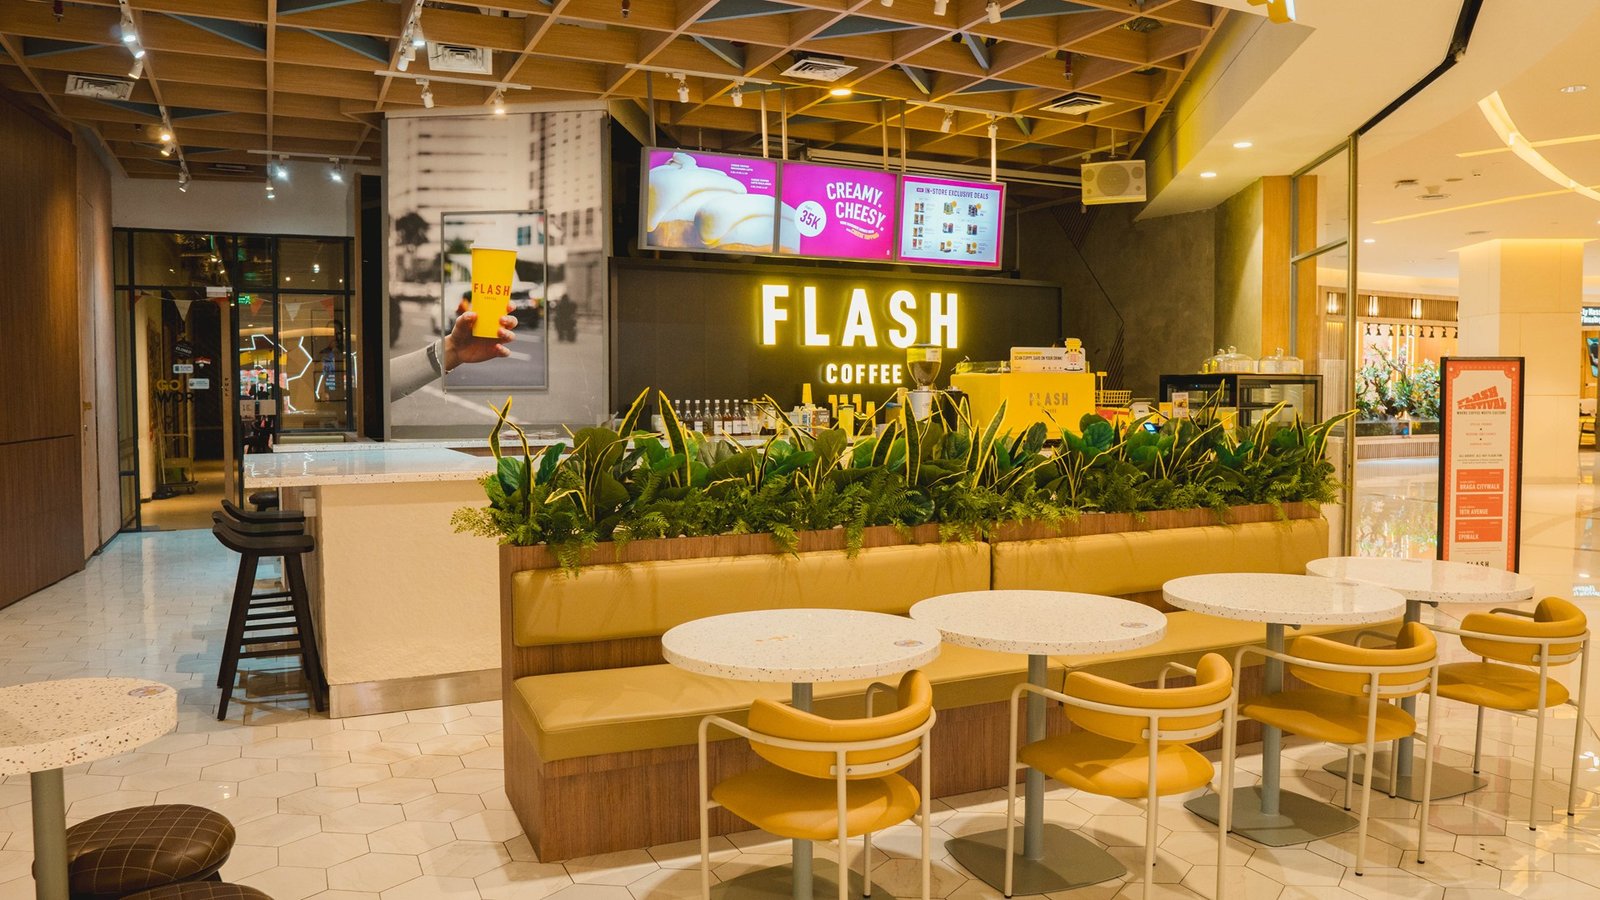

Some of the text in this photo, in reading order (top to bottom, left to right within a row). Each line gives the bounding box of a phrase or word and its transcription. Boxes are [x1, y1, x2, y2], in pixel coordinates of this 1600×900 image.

[826, 181, 883, 208] CREAMY.
[925, 187, 948, 196] IN-STORE
[948, 190, 974, 198] EXCLUSIVE
[800, 210, 821, 230] 35K
[835, 202, 886, 232] CHEESY.
[474, 283, 510, 296] FLASH
[762, 284, 958, 348] FLASH
[826, 364, 902, 384] COFFEE
[1457, 386, 1498, 404] FLASH
[1458, 397, 1506, 410] FESTIVAL
